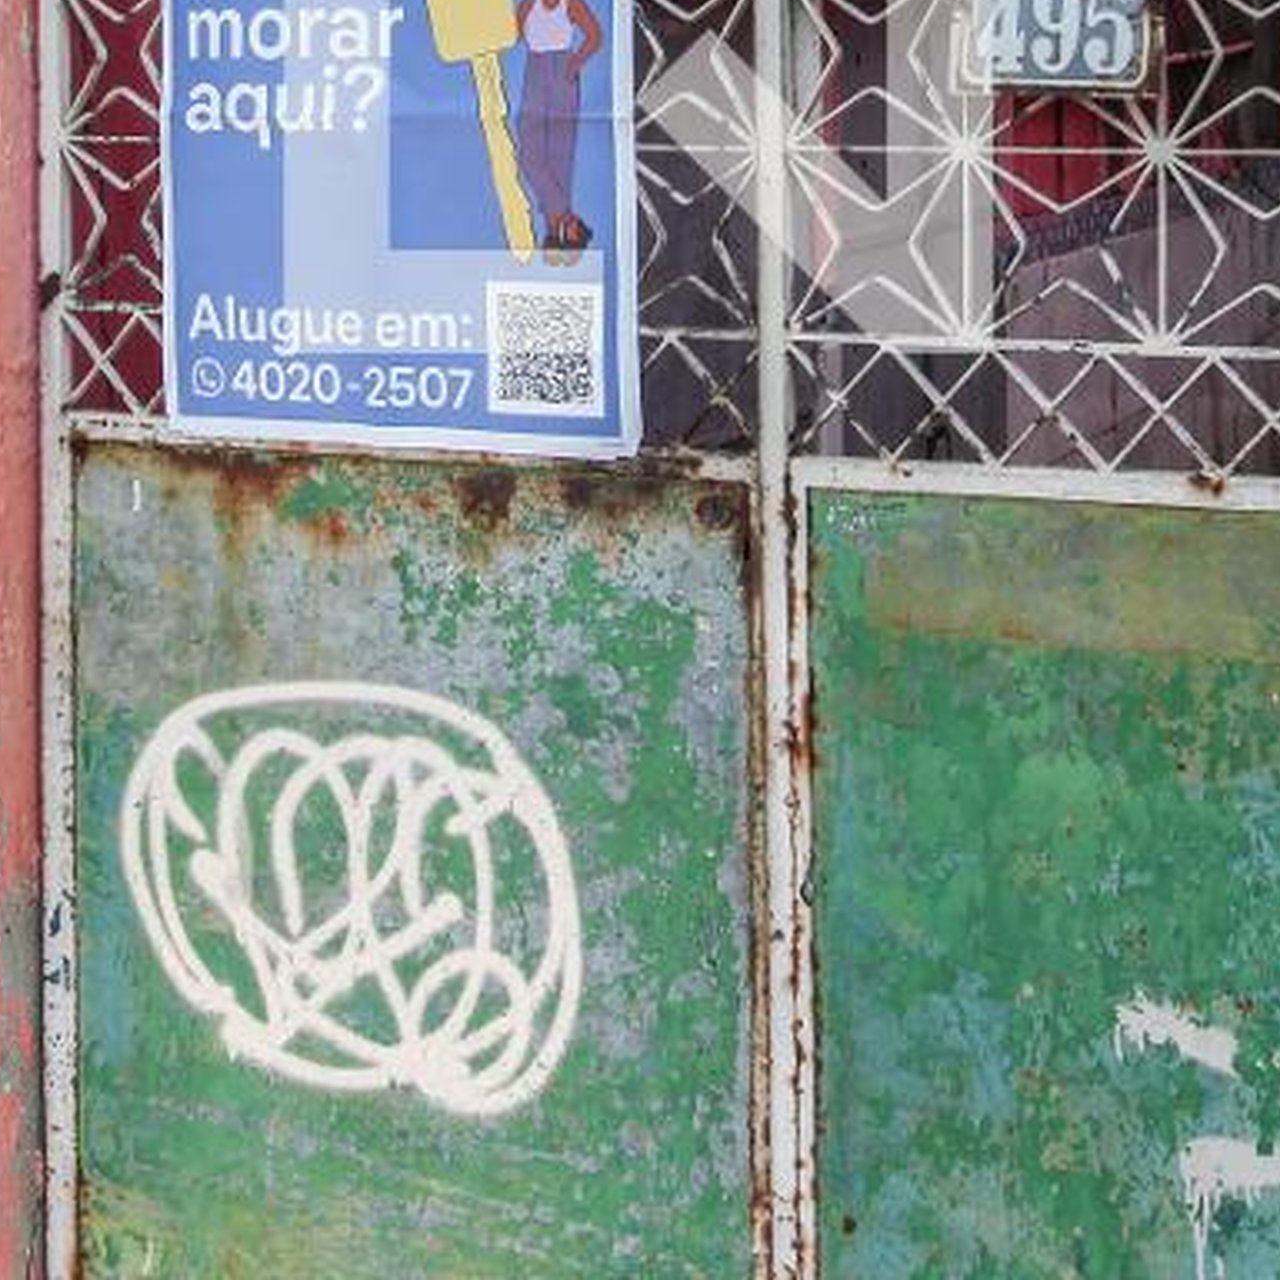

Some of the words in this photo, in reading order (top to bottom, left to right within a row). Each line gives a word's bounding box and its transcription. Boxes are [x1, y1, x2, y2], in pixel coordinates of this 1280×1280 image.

[187, 5, 404, 61] morar
[185, 66, 386, 151] aqui?
[189, 294, 362, 354] Alugue
[376, 311, 472, 348] em:
[231, 360, 474, 411] 4020-2507
